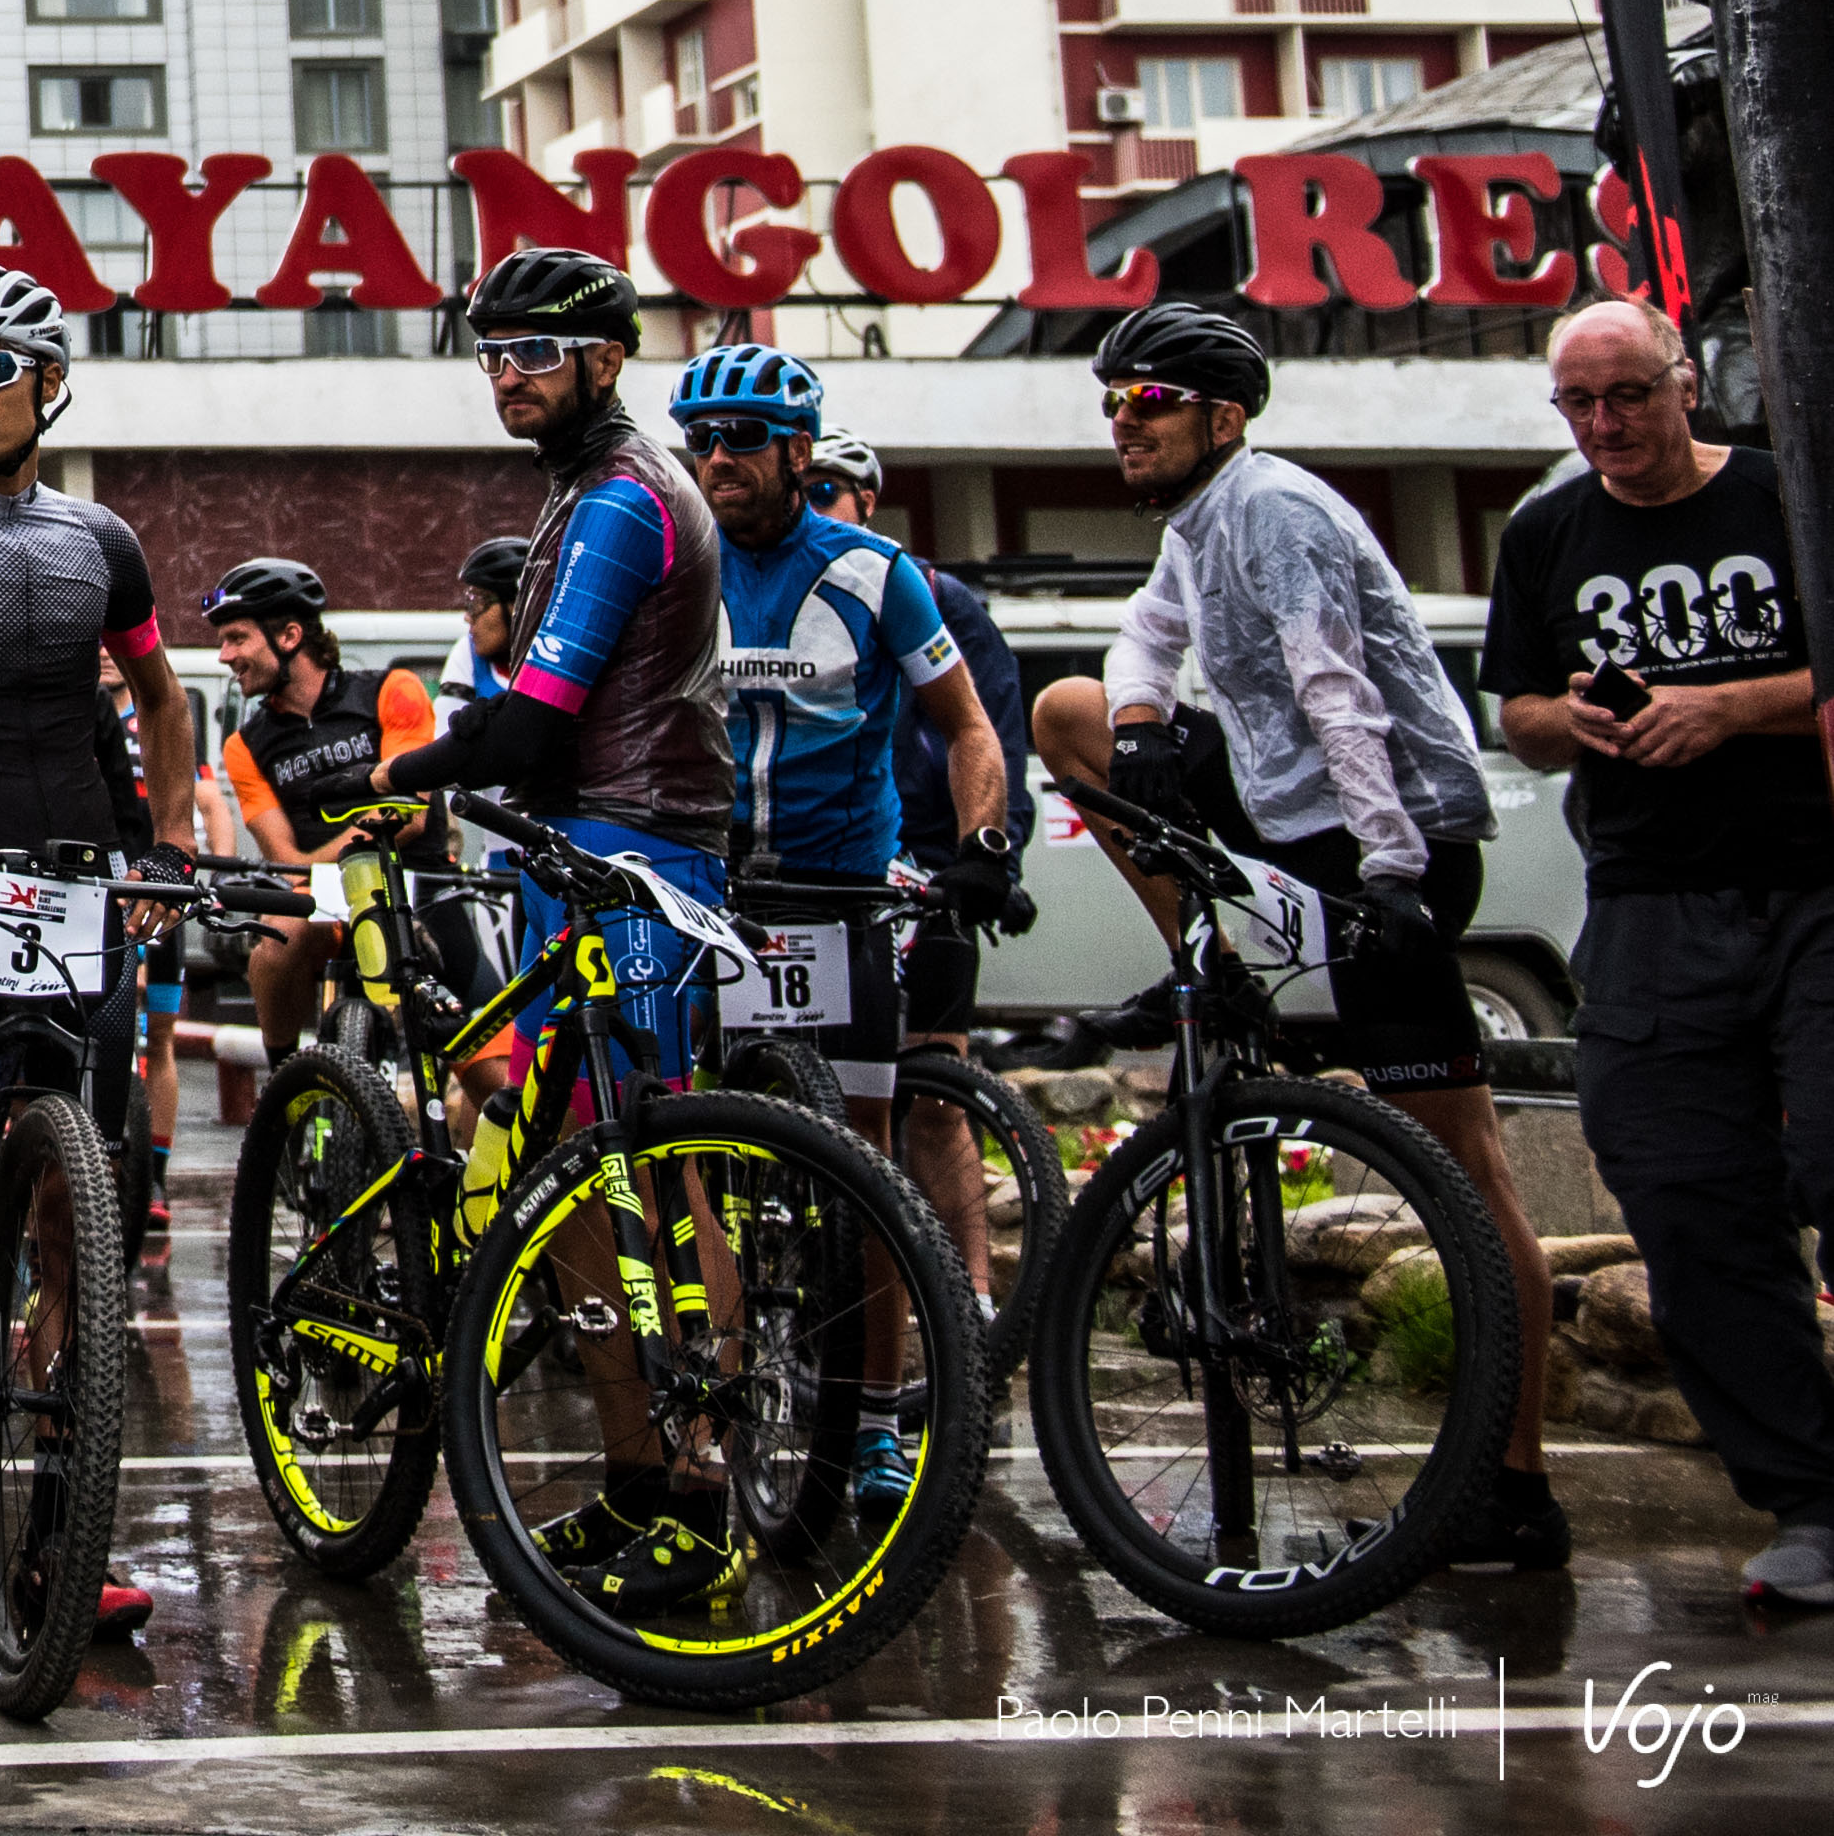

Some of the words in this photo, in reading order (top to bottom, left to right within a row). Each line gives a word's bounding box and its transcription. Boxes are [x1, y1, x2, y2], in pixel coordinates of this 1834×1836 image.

[719, 659, 817, 680] HIMANO
[274, 732, 375, 787] MOTION
[1491, 789, 1537, 810] MP
[10, 922, 43, 974] 3
[1276, 896, 1304, 951] 14
[769, 963, 811, 1009] 18
[1362, 1061, 1449, 1084] FUSION
[513, 1172, 561, 1229] ASPEN
[771, 1568, 885, 1664] MAXXIS
